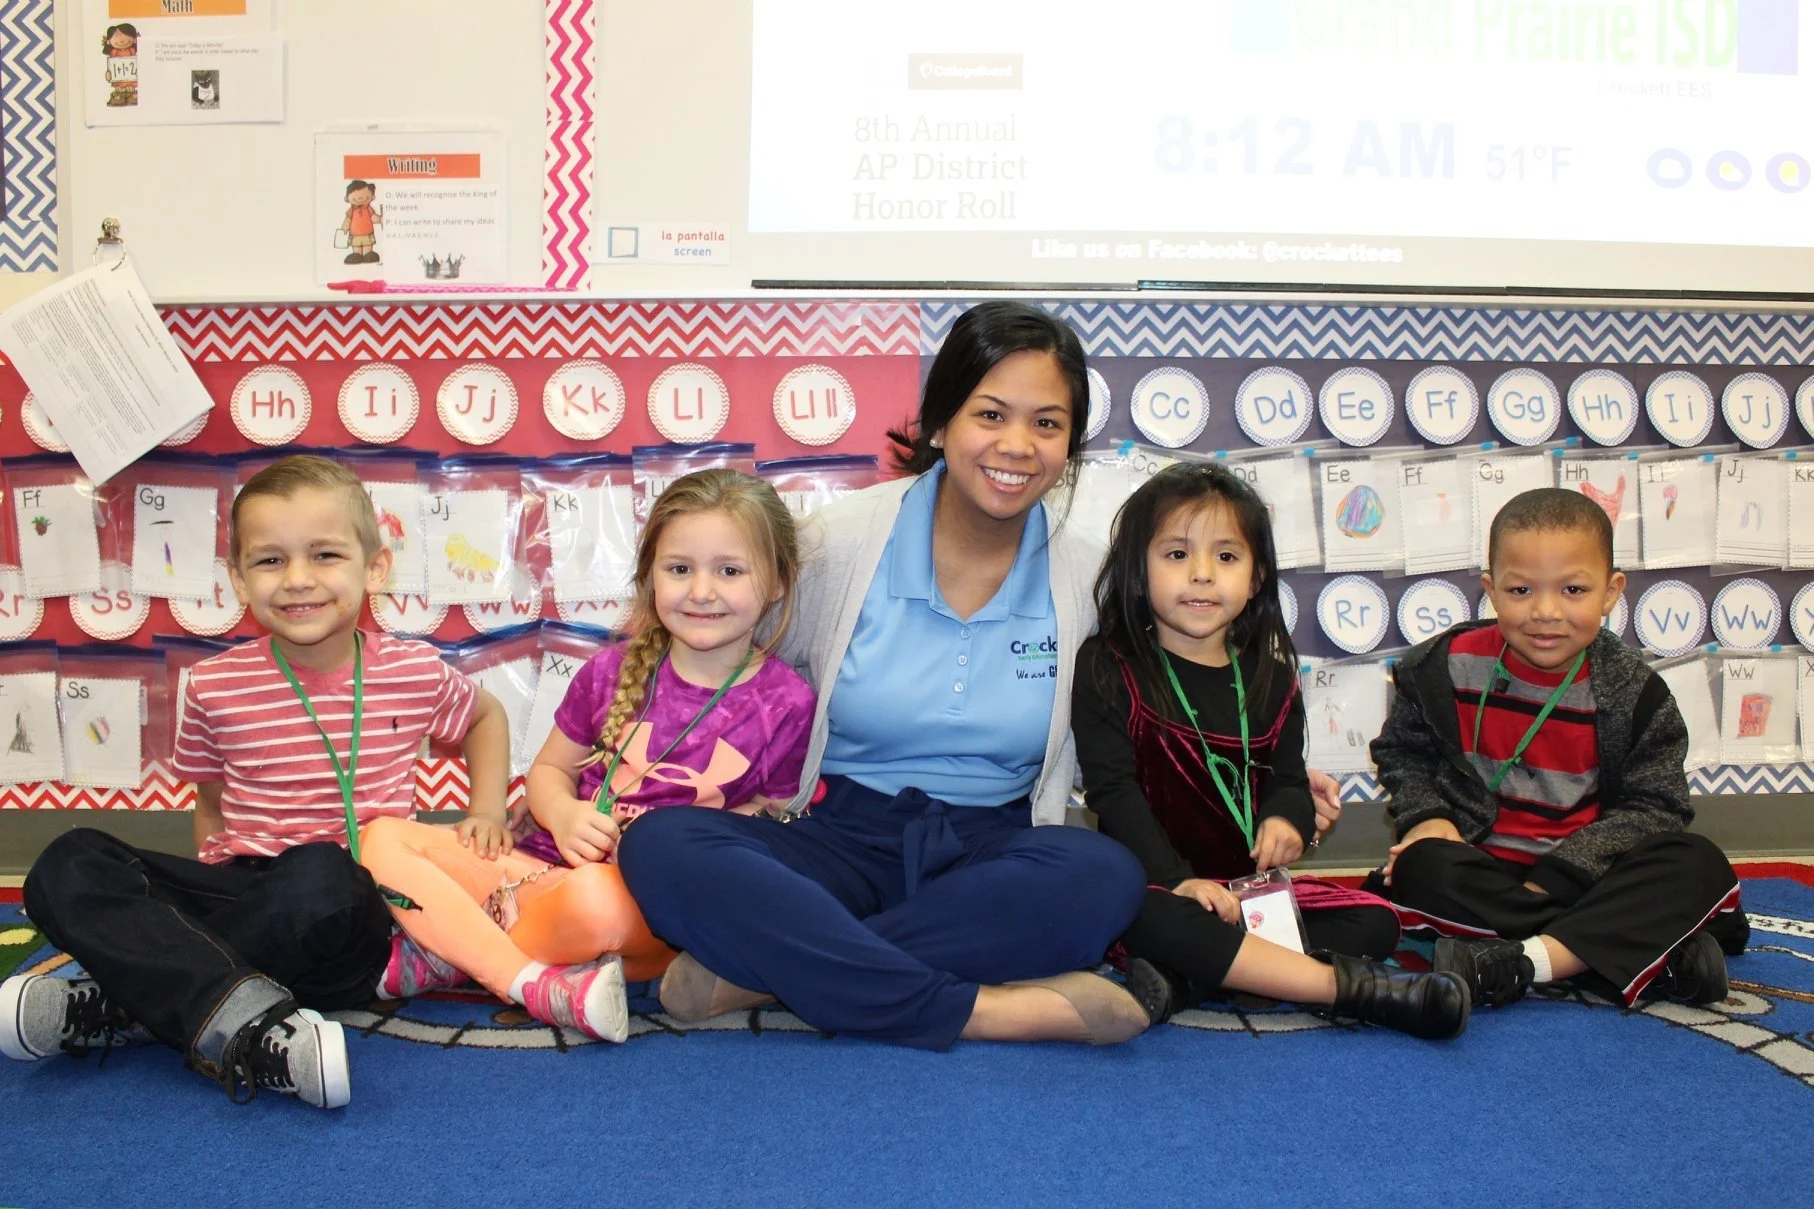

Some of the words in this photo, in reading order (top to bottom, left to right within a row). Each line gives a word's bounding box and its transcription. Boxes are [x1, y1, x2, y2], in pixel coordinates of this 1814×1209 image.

[162, 0, 194, 14] Math
[1474, 0, 1637, 64] Prairie
[1655, 0, 1737, 67] ISD
[1676, 81, 1712, 98] EES
[854, 113, 901, 143] 8th
[909, 113, 1017, 142] Annual
[1154, 114, 1315, 175] 8:12
[1341, 119, 1456, 180] AM
[1485, 145, 1573, 182] 51°F
[387, 158, 438, 175] Writing
[852, 152, 898, 181] AP
[911, 151, 1029, 181] District
[409, 191, 422, 199] will
[423, 191, 458, 200] recognize
[459, 190, 471, 198] the
[472, 190, 488, 199] King
[489, 190, 497, 198] of
[852, 191, 948, 220] Honor
[956, 190, 1017, 220] Roll
[412, 218, 431, 226] write
[442, 217, 462, 225] share
[463, 218, 475, 227] my
[661, 230, 672, 241] la
[677, 230, 725, 244] pantalla
[1031, 239, 1077, 259] Like
[1083, 241, 1109, 259] us
[1114, 241, 1142, 259] on
[673, 247, 712, 257] screen
[250, 389, 296, 421] Hh
[455, 384, 497, 424] Jj
[561, 383, 611, 417] Kk
[1150, 391, 1190, 420] Cc
[1254, 389, 1298, 425] Dd
[1337, 391, 1375, 421] Ee
[1425, 390, 1458, 420] Ff
[1503, 390, 1546, 423] Gg
[1582, 393, 1624, 421] Hh
[1739, 395, 1772, 429] Jj
[1326, 465, 1351, 483] Ee
[1404, 466, 1423, 485] Ff
[1478, 463, 1505, 484] Gg
[1565, 463, 1589, 480] Hh
[1727, 459, 1744, 483] Jj
[22, 490, 42, 508] Ff
[139, 487, 165, 511] Gg
[430, 496, 450, 522] Jj
[91, 587, 133, 615] Ss
[1335, 599, 1371, 630] Rr
[1415, 606, 1453, 634] Ss
[1649, 607, 1690, 634] Vv
[1721, 603, 1773, 631] Ww
[546, 655, 573, 678] Xx
[1016, 668, 1028, 680] We
[1315, 670, 1336, 686] Rr
[1728, 663, 1755, 680] Ww
[66, 681, 90, 699] Ss
